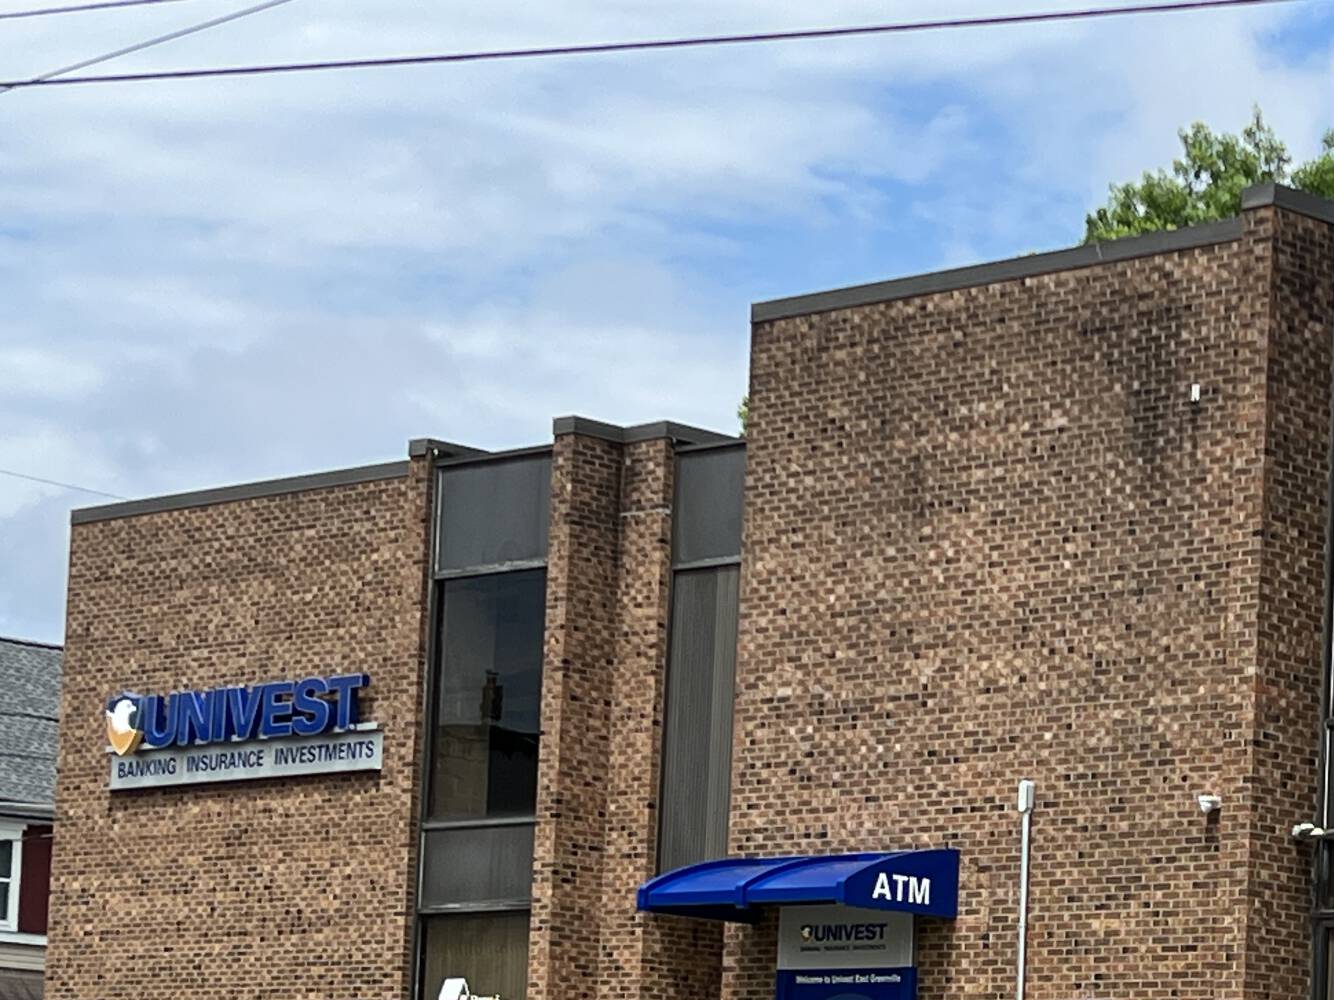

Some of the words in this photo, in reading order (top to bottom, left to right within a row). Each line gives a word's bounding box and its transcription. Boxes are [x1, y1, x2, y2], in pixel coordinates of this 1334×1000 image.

[142, 673, 370, 748] UNIVEST
[117, 757, 177, 779] BANKING
[186, 749, 265, 773] INSURANCE
[274, 740, 375, 766] INVESTMENTS
[872, 872, 931, 905] ATM
[814, 923, 888, 942] UNIVEST
